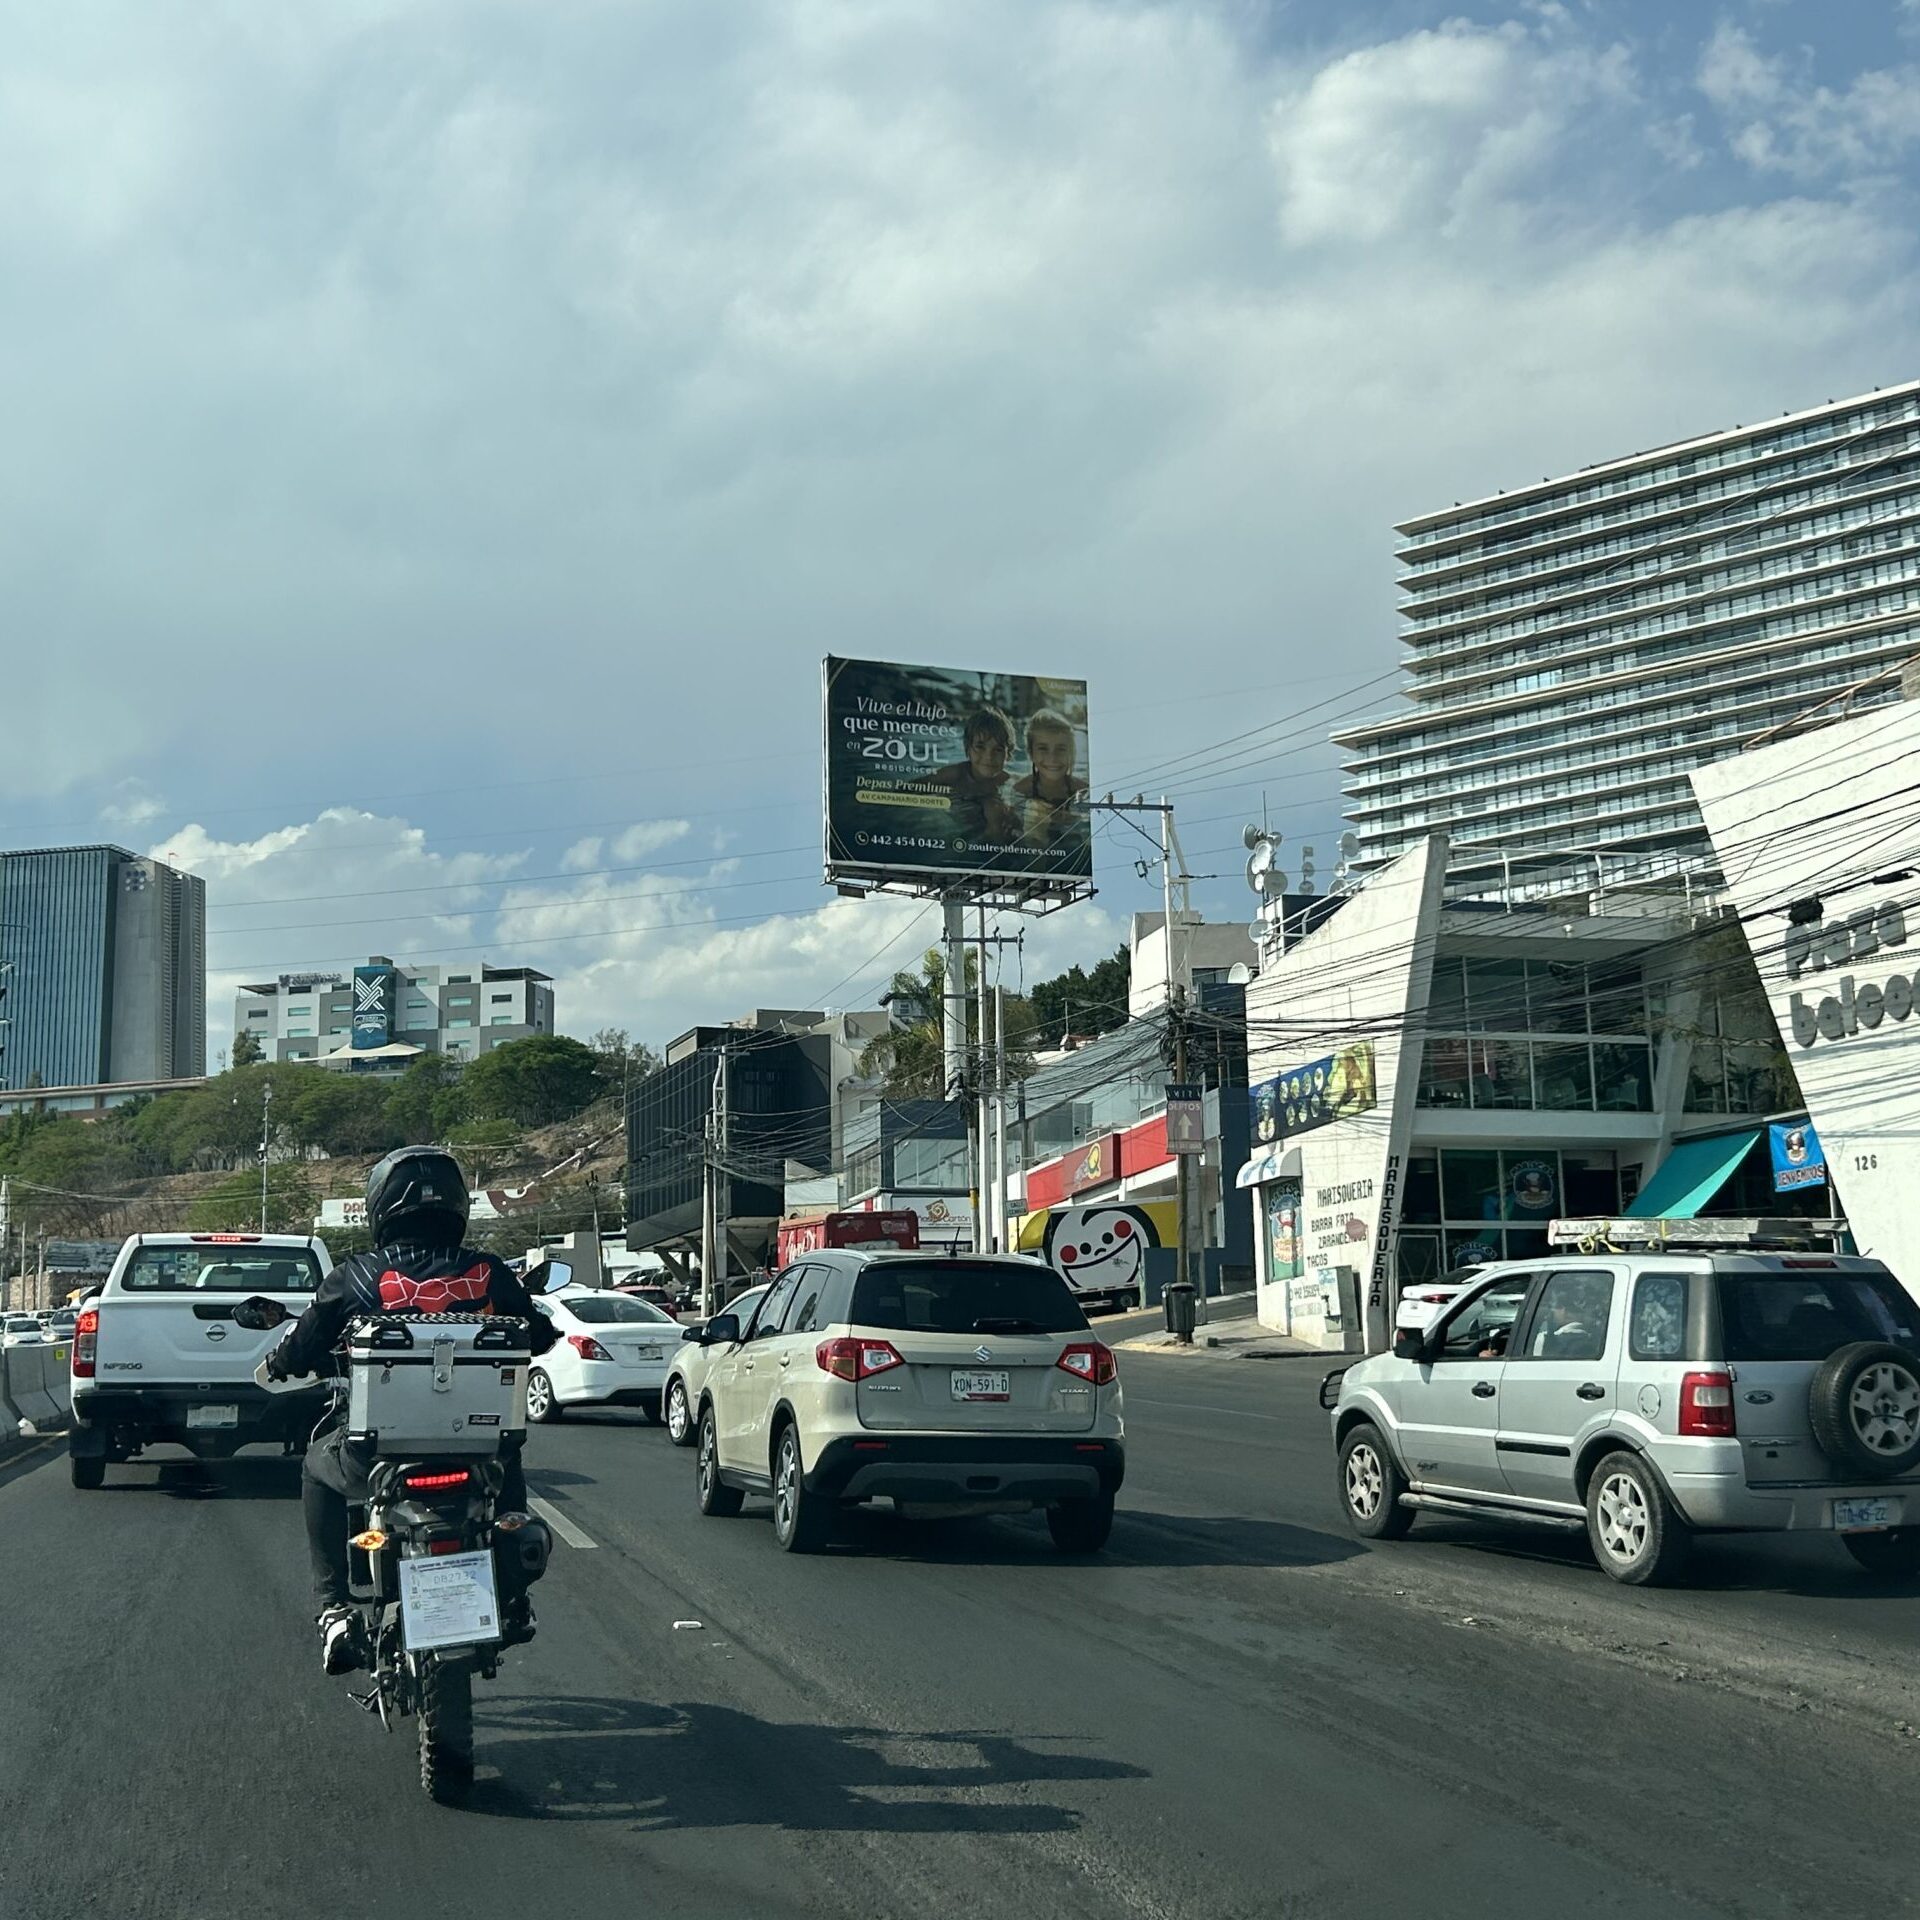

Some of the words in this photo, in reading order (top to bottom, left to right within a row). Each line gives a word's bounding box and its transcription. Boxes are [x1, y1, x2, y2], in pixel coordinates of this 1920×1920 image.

[857, 696, 893, 715] Vive
[896, 701, 912, 716] el
[915, 702, 947, 721] lujo
[843, 717, 879, 733] que
[883, 720, 958, 738] mereces
[846, 741, 860, 750] en
[856, 776, 892, 790] Depas
[895, 779, 951, 794] Premium
[871, 834, 892, 846] 442
[894, 835, 916, 847] 454
[918, 837, 946, 849] 0422
[968, 842, 1067, 857] zoulresidences.com
[1855, 1154, 1878, 1171] 126
[1317, 1179, 1373, 1208] MARISQUERIA
[1311, 1216, 1333, 1233] BARRA
[1370, 1156, 1400, 1307] MARISQUERIA
[1318, 1231, 1367, 1249] ZARANDEOS
[1307, 1253, 1328, 1269] TACOS
[103, 1362, 143, 1370] NP300
